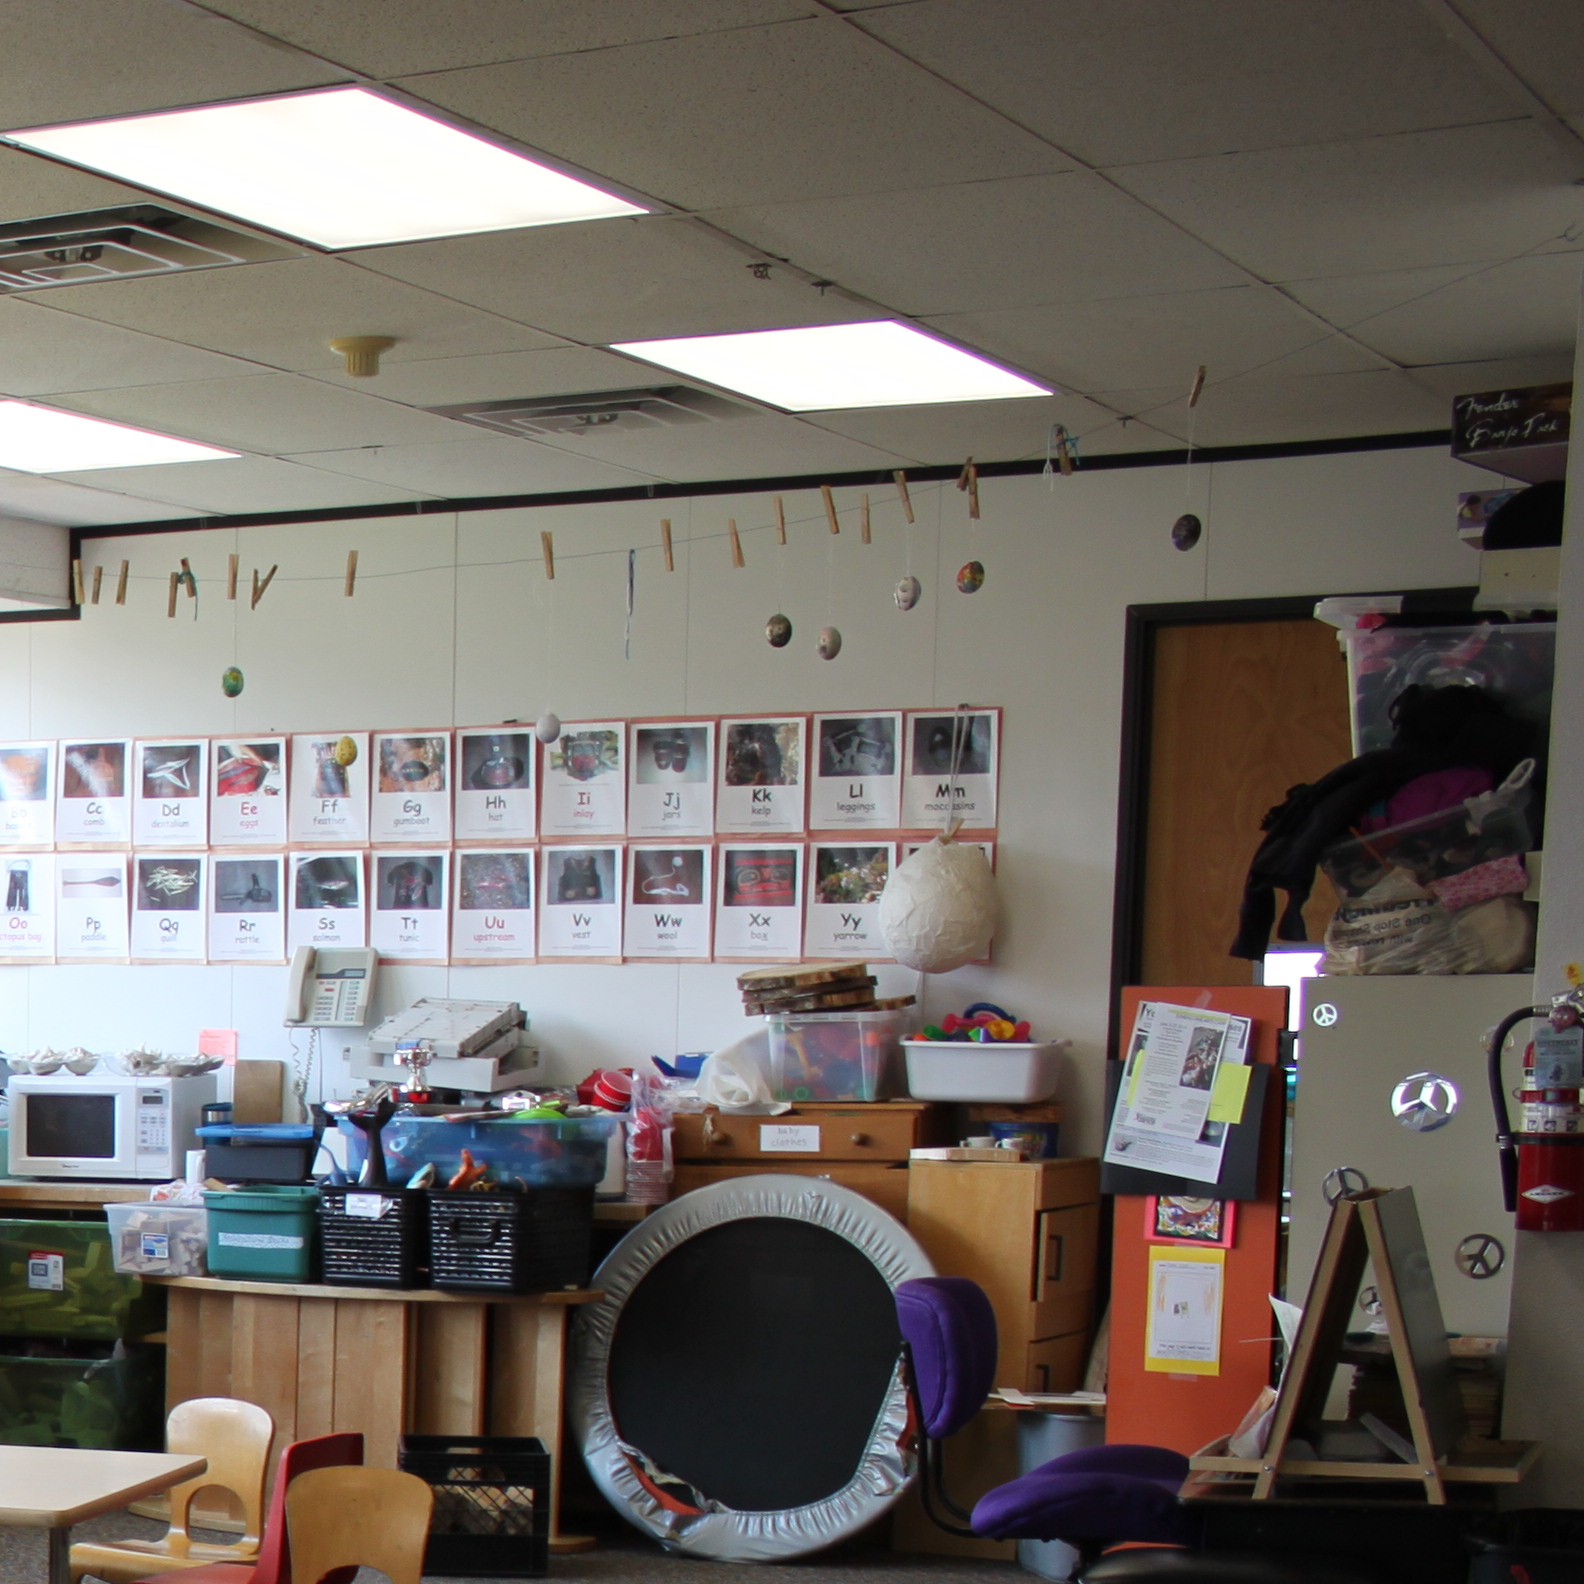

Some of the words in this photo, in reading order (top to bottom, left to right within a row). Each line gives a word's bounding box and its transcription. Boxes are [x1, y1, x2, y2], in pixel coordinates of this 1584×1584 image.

[1456, 392, 1519, 419] Fender
[1466, 419, 1519, 448] Banjo
[1522, 412, 1559, 438] Pack
[751, 789, 772, 803] Kk
[936, 784, 965, 798] Mm
[486, 796, 506, 809] Hh
[577, 792, 591, 805] Ii
[663, 792, 681, 810] Jj
[86, 802, 103, 815] Cc
[162, 803, 180, 816] Dd
[240, 802, 258, 815] Ee
[321, 800, 338, 813] Ff
[403, 800, 422, 816] Gg
[751, 805, 771, 817] kelp
[836, 802, 876, 812] leggings
[488, 811, 503, 821] hat
[573, 809, 594, 819] inlay
[662, 810, 681, 821] jars
[83, 817, 105, 826] comb
[152, 818, 189, 828] dentalium
[239, 818, 259, 828] eggs
[313, 816, 346, 825] feather
[393, 816, 429, 826] gumboot
[9, 917, 28, 929] Oo
[86, 917, 101, 933] Pp
[239, 919, 256, 932] Rr
[318, 918, 335, 930] Ss
[401, 917, 418, 930] Tt
[485, 917, 505, 929] Uu
[573, 914, 591, 926] Vv
[654, 914, 682, 927] Ww
[749, 914, 771, 926] Xx
[841, 913, 861, 931] Yy
[159, 918, 179, 935] Qq
[28, 933, 41, 942] bag
[81, 933, 107, 942] paddle
[161, 934, 176, 943] quill
[235, 935, 260, 944] rattle
[313, 933, 340, 942] salmon
[399, 933, 419, 942] tunic
[473, 932, 515, 942] upstream
[572, 930, 591, 939] vest
[657, 931, 677, 939] wool
[750, 931, 768, 941] box
[833, 932, 867, 941] yarrow
[777, 1127, 800, 1137] baby
[770, 1138, 808, 1147] clothes
